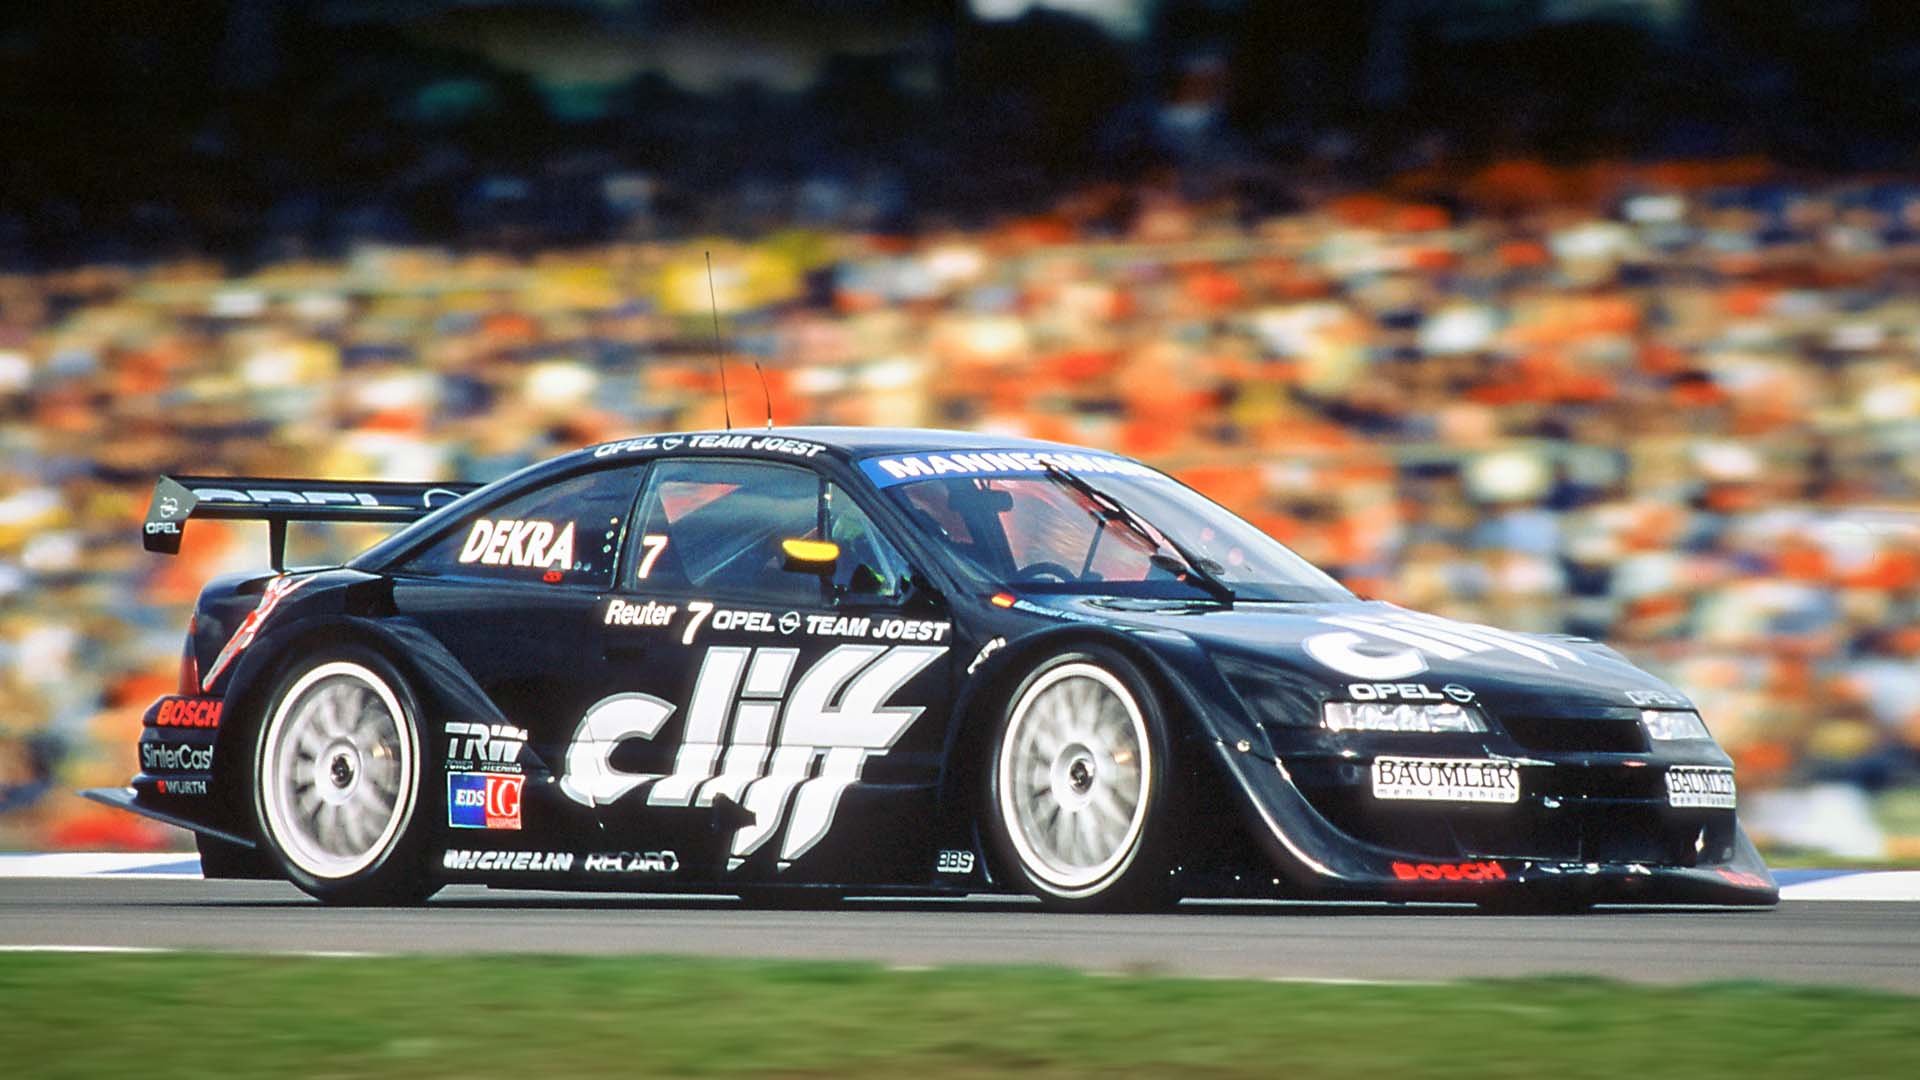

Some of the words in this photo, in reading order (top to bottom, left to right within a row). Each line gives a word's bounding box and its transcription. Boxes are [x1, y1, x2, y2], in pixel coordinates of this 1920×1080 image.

[594, 436, 658, 458] OPEL
[688, 435, 753, 449] TEAM
[752, 438, 826, 457] JOEST
[146, 522, 180, 534] OPEL
[458, 519, 576, 570] DEKRA
[637, 535, 669, 579] 7
[604, 600, 678, 626] Reuter
[681, 601, 713, 646] 7
[712, 610, 775, 632] OPEL
[805, 615, 871, 637] TEAM
[872, 620, 951, 641] JOEST
[1348, 683, 1444, 701] OPEL
[156, 699, 224, 728] BOSCH
[444, 722, 528, 763] TRW
[142, 743, 215, 770] SinterCast
[560, 643, 950, 871] cliff
[455, 788, 486, 807] EDS
[443, 849, 574, 871] MICHELIN
[936, 850, 975, 873] BBS
[1393, 860, 1506, 881] BOSCH
